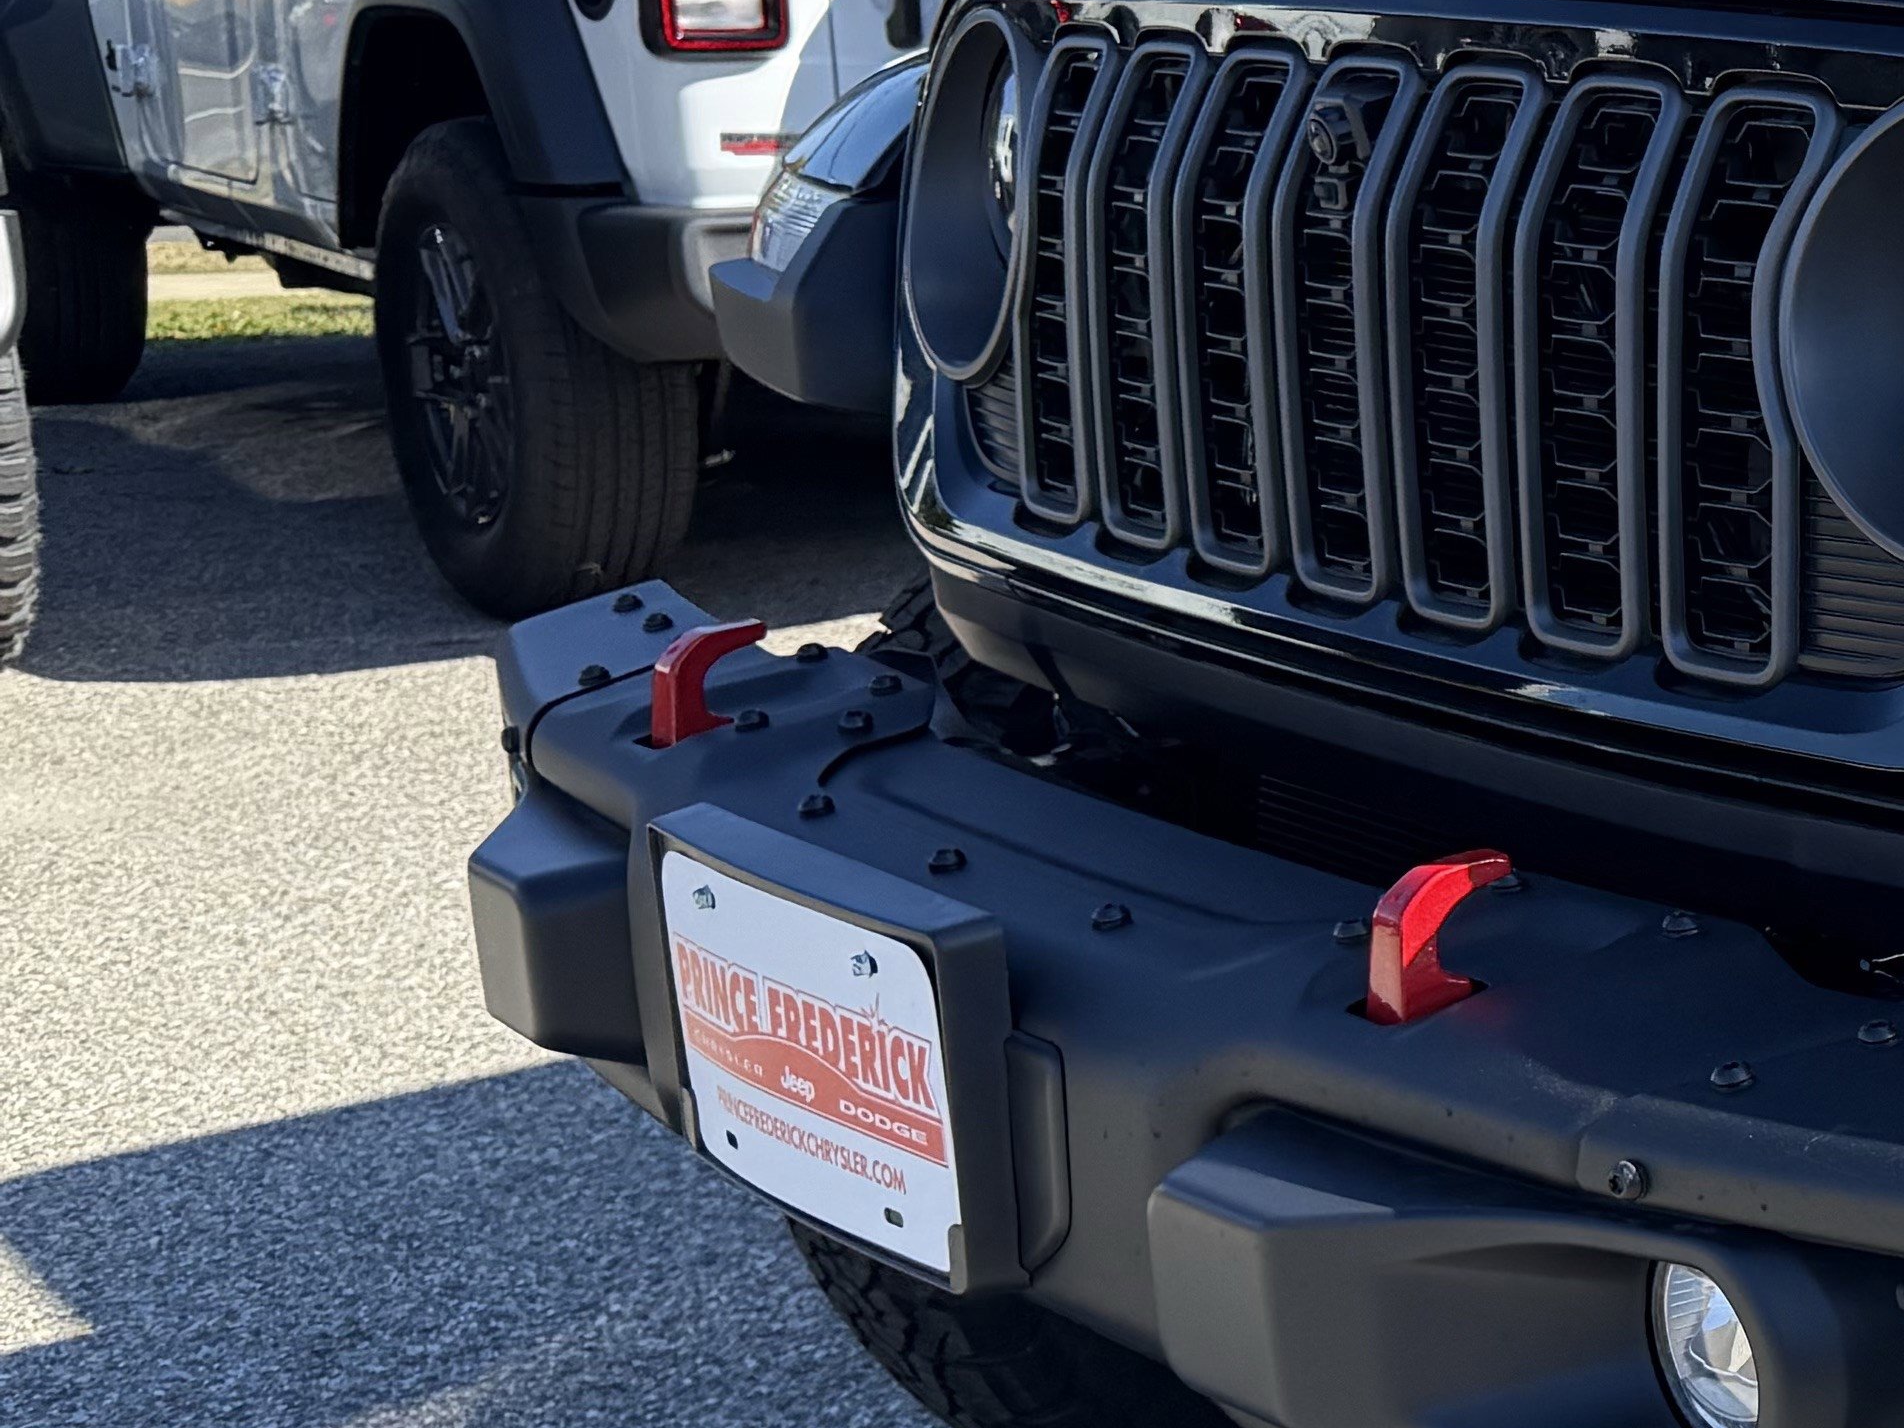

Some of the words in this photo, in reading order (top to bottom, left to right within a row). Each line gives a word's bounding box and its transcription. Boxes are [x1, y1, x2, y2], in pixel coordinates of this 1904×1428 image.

[676, 941, 759, 1035] PRINCE
[767, 985, 937, 1112] FREDERICK
[779, 1065, 816, 1104] Jeep
[839, 1098, 930, 1146] DODGE
